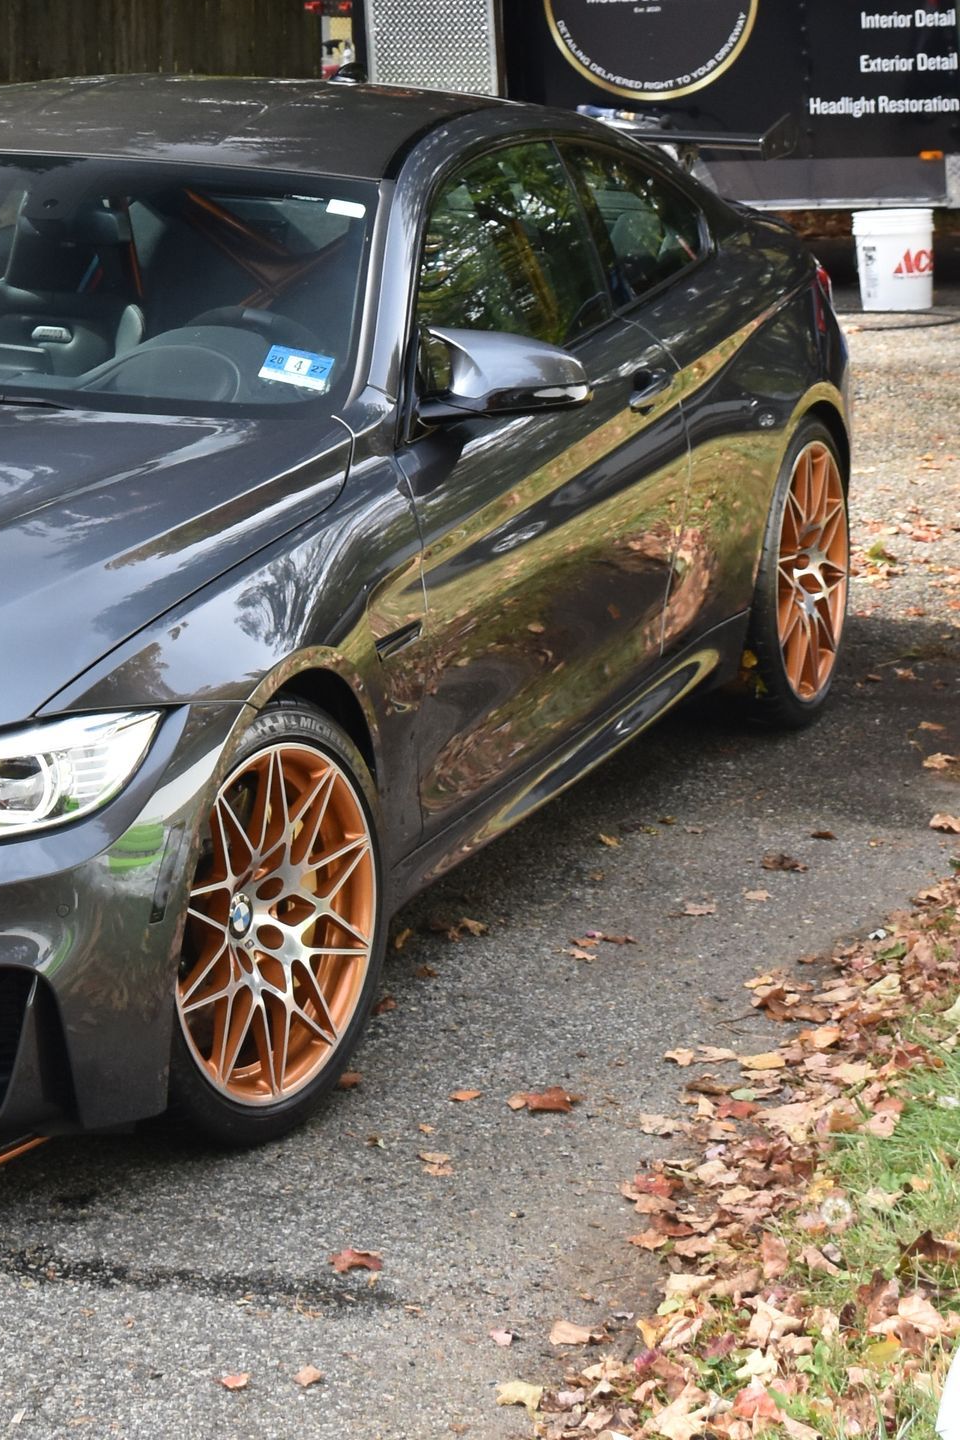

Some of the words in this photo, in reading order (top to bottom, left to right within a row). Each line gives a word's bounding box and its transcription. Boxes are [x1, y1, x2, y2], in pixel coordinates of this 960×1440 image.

[860, 11, 913, 29] Interior
[914, 9, 956, 27] Detail
[556, 20, 591, 67] DETAILING
[589, 62, 643, 90] DELIVERED
[643, 79, 674, 90] RIGHT
[675, 75, 691, 85] TO
[690, 57, 717, 78] YOUR
[714, 11, 746, 62] DRIVEWAY
[859, 54, 914, 73] Exterior
[916, 52, 958, 71] Detail
[809, 96, 876, 118] Headlight
[877, 95, 960, 113] Restoration
[893, 248, 934, 273] AC
[270, 355, 284, 364] 20
[294, 360, 303, 371] 4
[311, 365, 327, 374] 27
